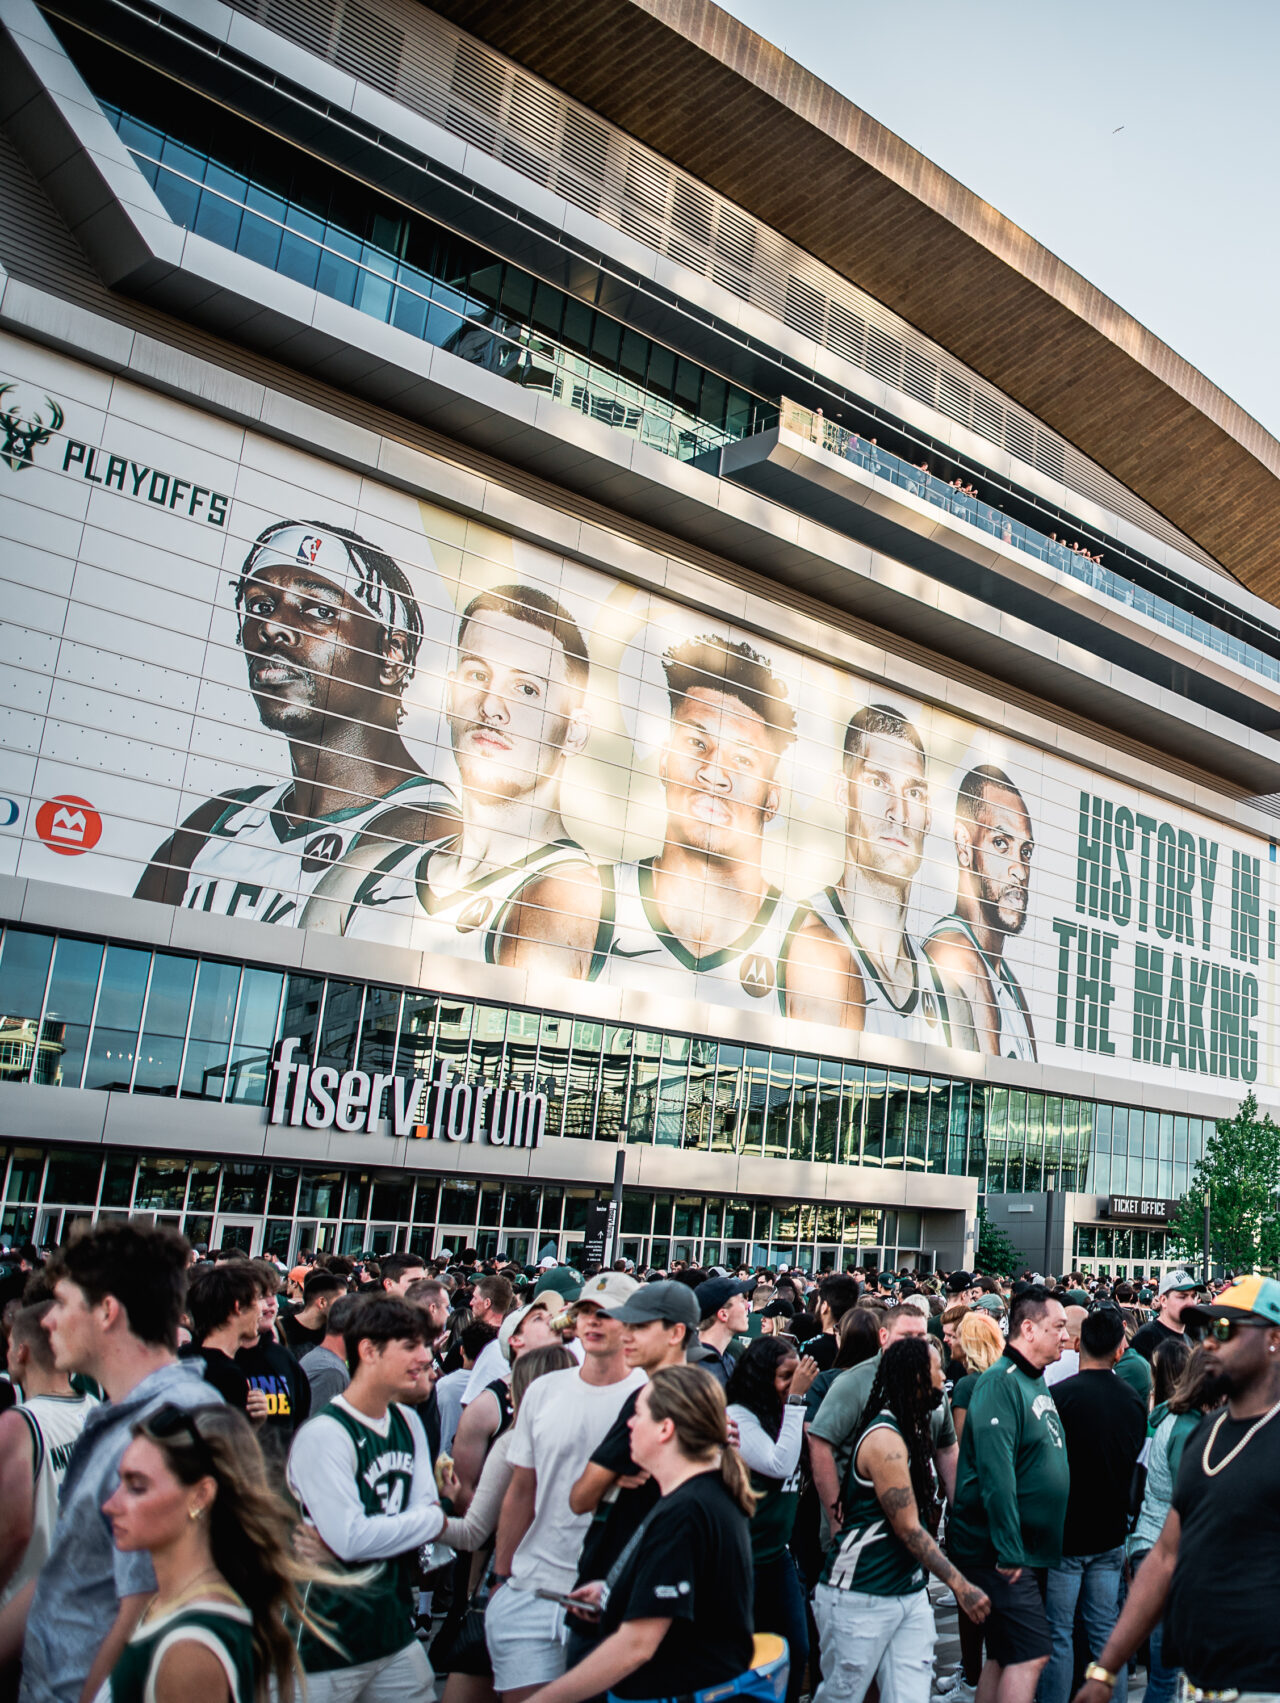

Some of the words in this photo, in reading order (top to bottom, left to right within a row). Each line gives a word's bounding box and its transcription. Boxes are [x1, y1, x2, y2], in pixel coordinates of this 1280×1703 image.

[62, 439, 229, 527] PLAYOFFS
[1075, 791, 1218, 951] HISTORY
[1230, 849, 1260, 965] IN
[1053, 917, 1119, 1057] THE
[1132, 941, 1258, 1084] MAKING
[1114, 1199, 1138, 1213] TICKET
[1141, 1200, 1166, 1215] OFFICE
